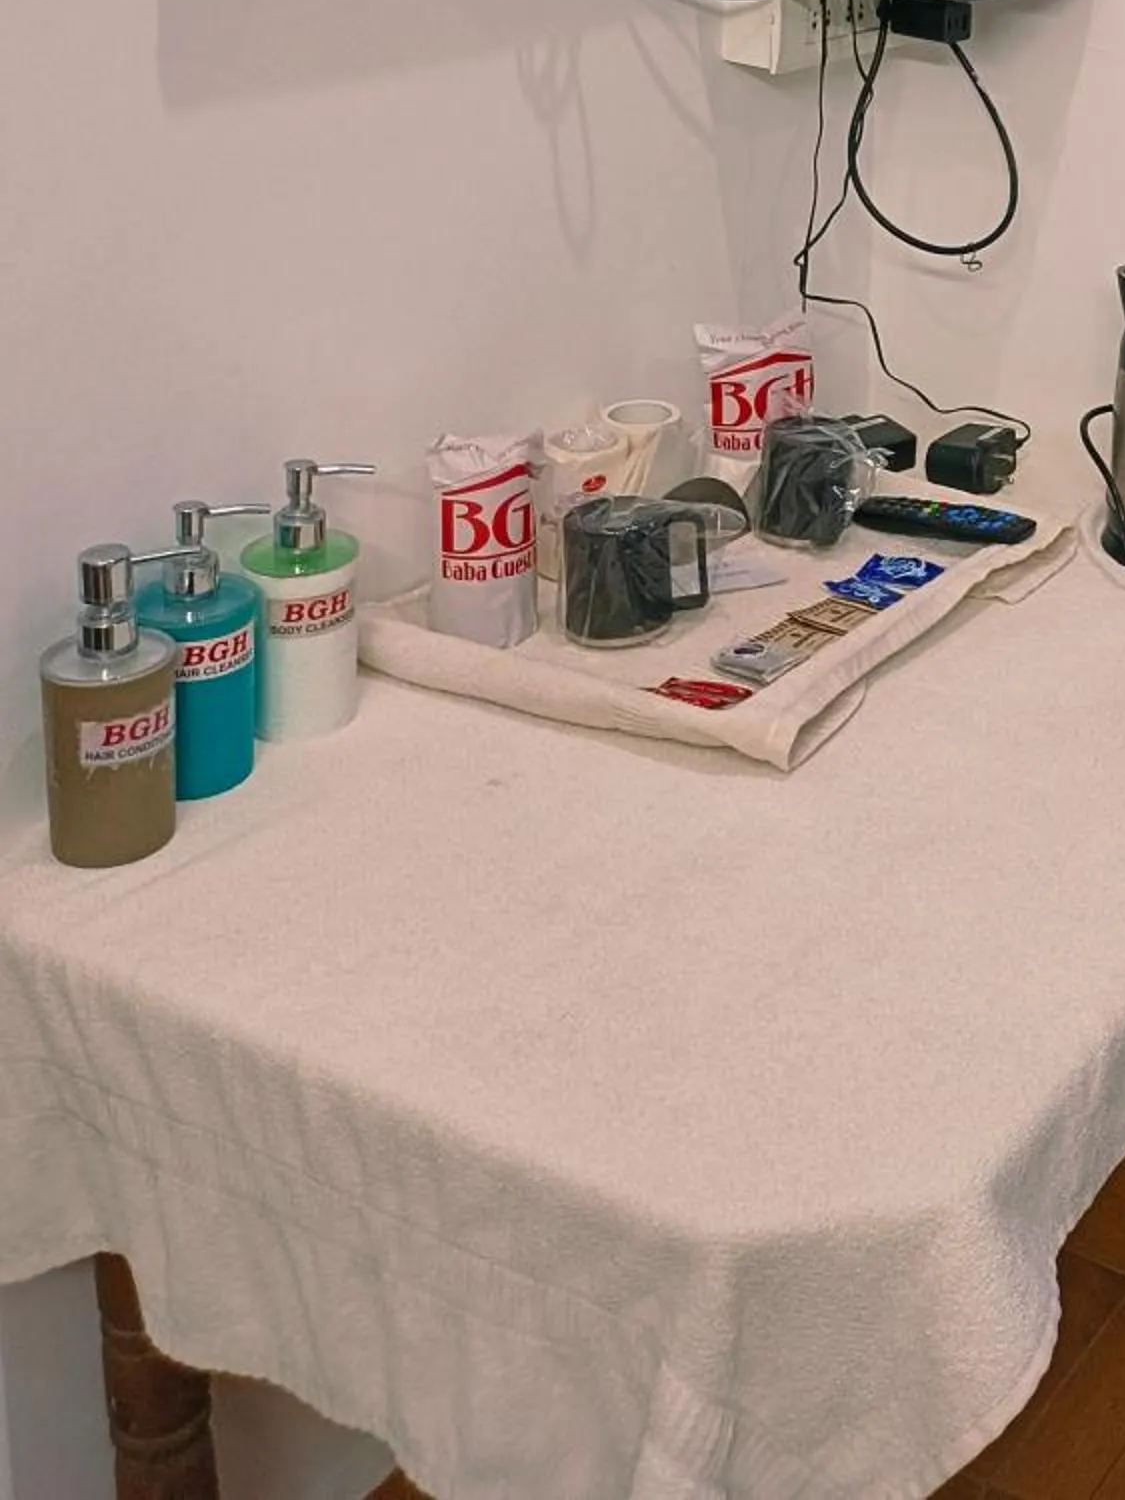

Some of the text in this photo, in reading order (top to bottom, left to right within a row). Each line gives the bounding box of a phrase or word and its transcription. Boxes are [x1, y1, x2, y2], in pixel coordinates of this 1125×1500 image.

[442, 489, 536, 554] BG
[442, 559, 487, 581] Baba
[282, 590, 349, 623] BGH
[183, 631, 248, 667] BGH
[101, 707, 169, 747] BGH
[85, 750, 115, 761] HAIR
